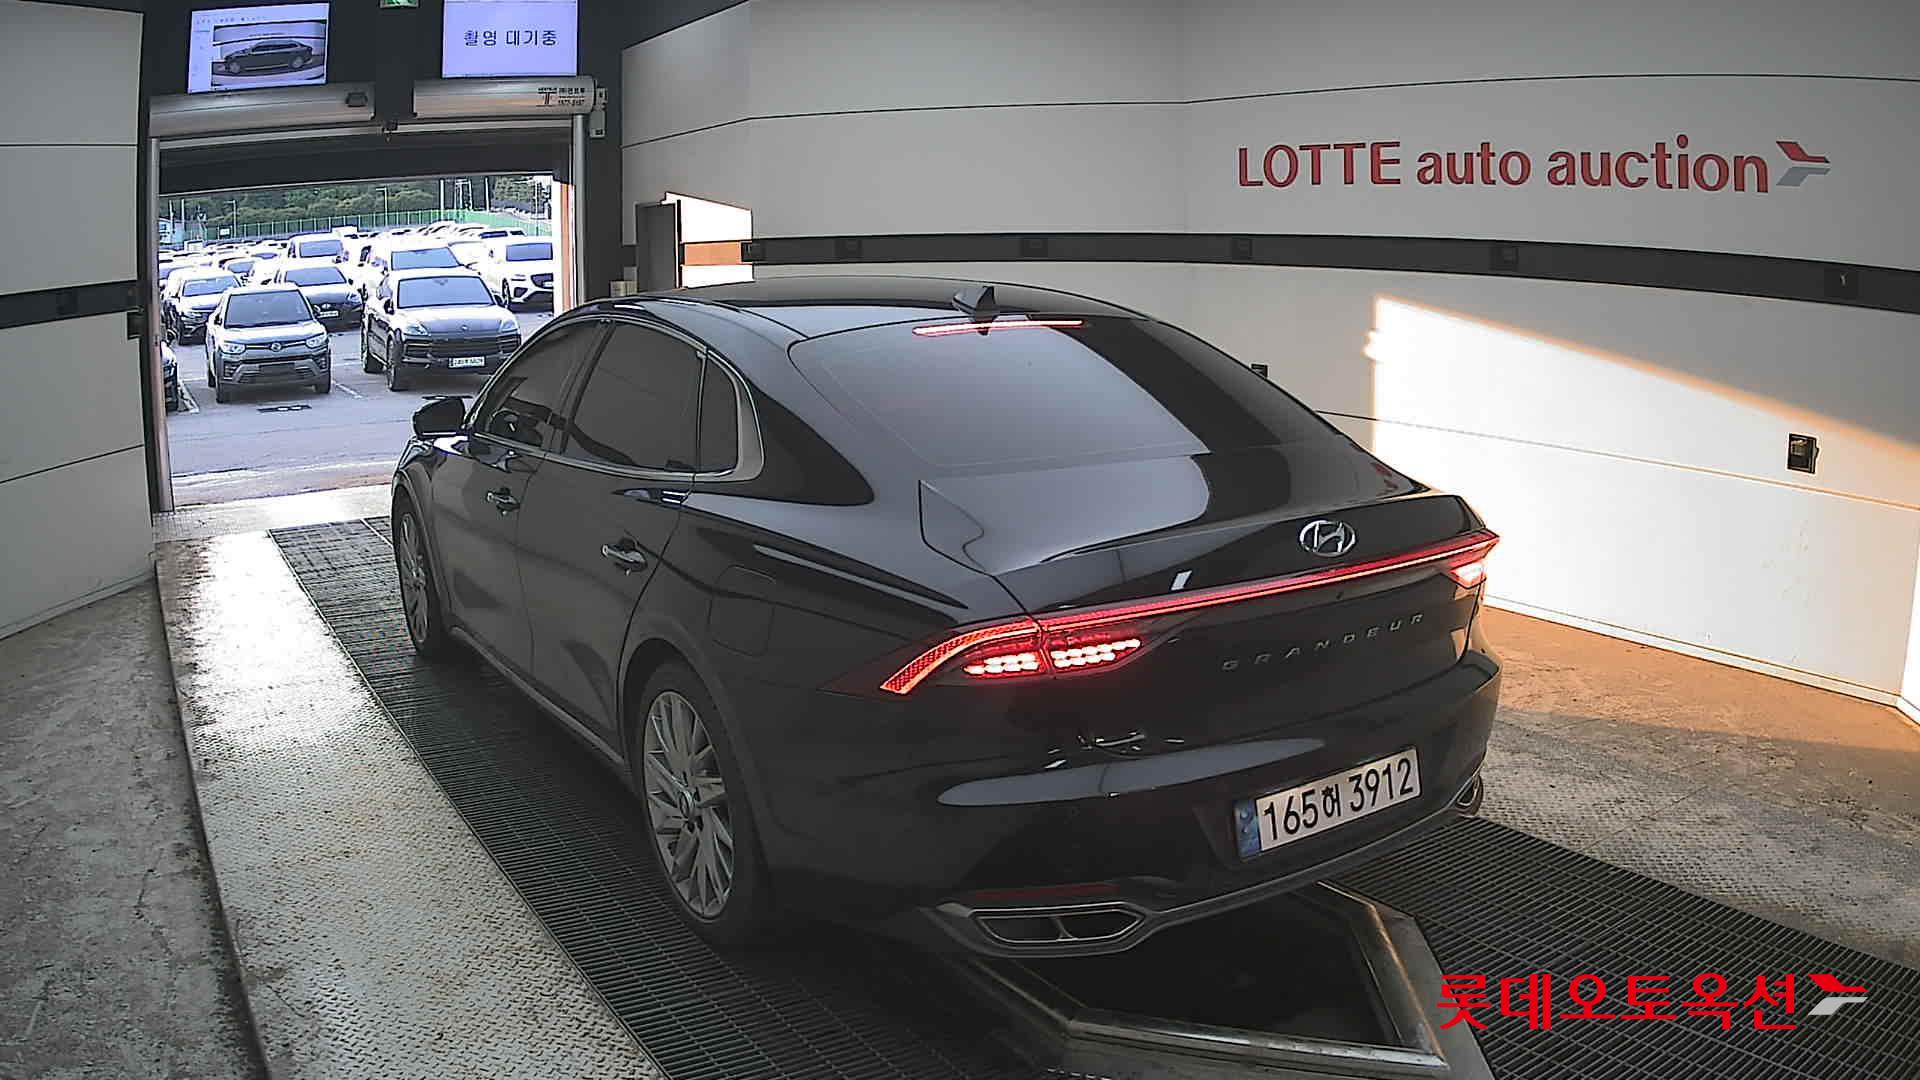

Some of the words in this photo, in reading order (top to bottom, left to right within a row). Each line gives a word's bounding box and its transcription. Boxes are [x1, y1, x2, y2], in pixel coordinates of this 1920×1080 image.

[464, 30, 497, 47] 촬영
[505, 30, 558, 47] 대기중
[1238, 141, 1401, 187] LOTTE
[1416, 142, 1532, 186] auto
[1547, 134, 1769, 193] auction
[1222, 613, 1424, 671] GRANDEUR
[1348, 757, 1414, 812] 3912
